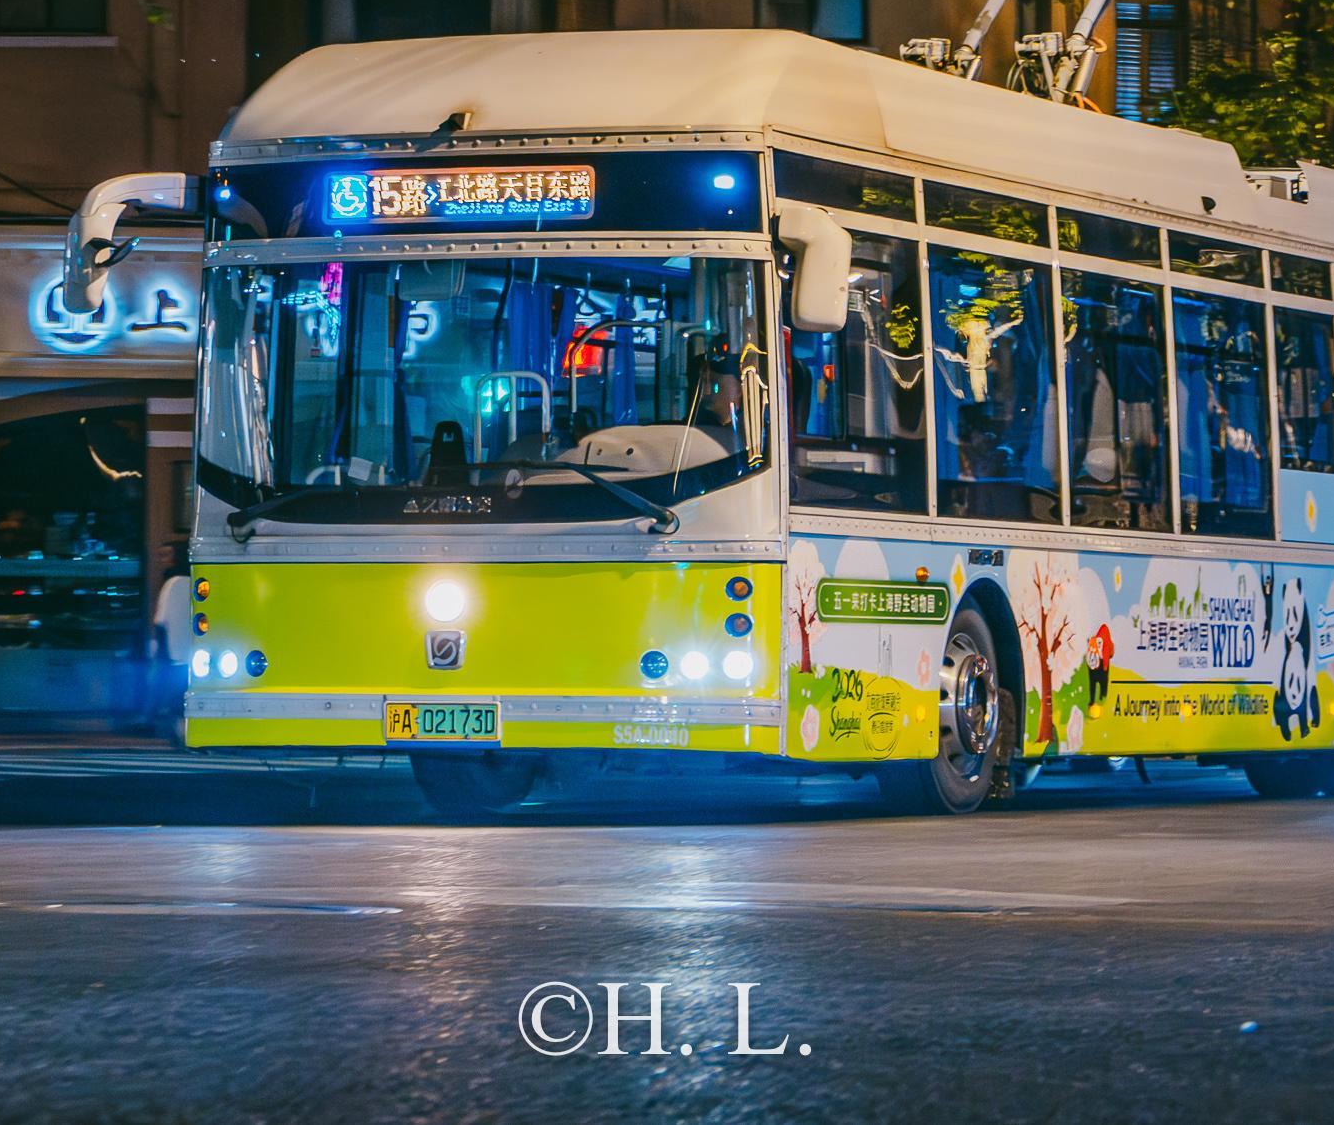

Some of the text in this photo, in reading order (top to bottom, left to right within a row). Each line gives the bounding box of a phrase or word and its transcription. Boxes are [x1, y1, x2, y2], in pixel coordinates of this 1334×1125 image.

[368, 174, 429, 216] 15路
[544, 200, 575, 213] East
[833, 591, 936, 614] 五一来打卡上海野生动物园
[1208, 596, 1256, 623] SHANGHAI
[1136, 619, 1209, 652] 上海野生动物园
[1210, 623, 1255, 668] WILD
[1114, 693, 1121, 716] A
[1124, 693, 1160, 722] Journey
[1163, 694, 1180, 716] into
[1200, 693, 1226, 716] World
